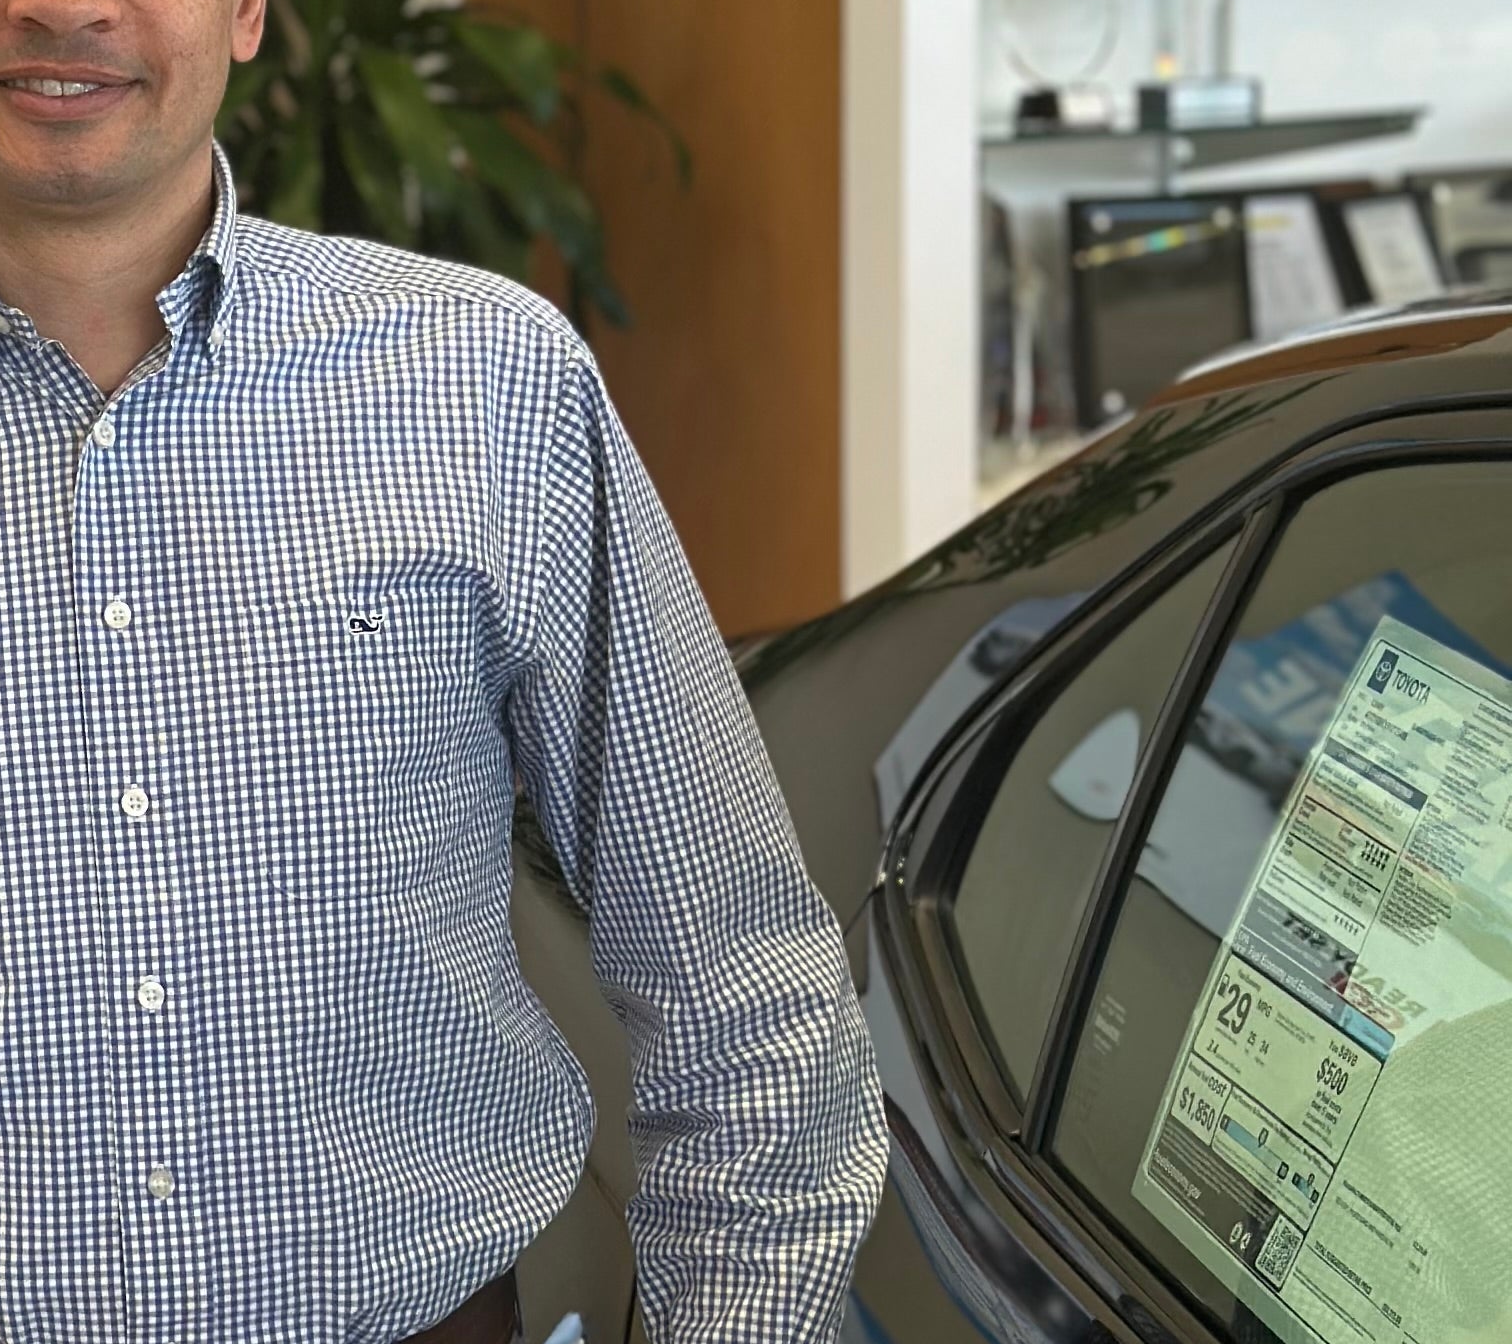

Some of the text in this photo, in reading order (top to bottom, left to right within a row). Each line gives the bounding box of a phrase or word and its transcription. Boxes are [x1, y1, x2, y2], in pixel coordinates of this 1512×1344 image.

[1391, 668, 1432, 705] TOYOTA
[1217, 983, 1252, 1034] 29
[1257, 999, 1273, 1018] MPG
[1338, 1045, 1359, 1067] save
[1206, 1076, 1227, 1098] cost
[1316, 1056, 1349, 1096] $500
[1179, 1086, 1216, 1132] $1,850
